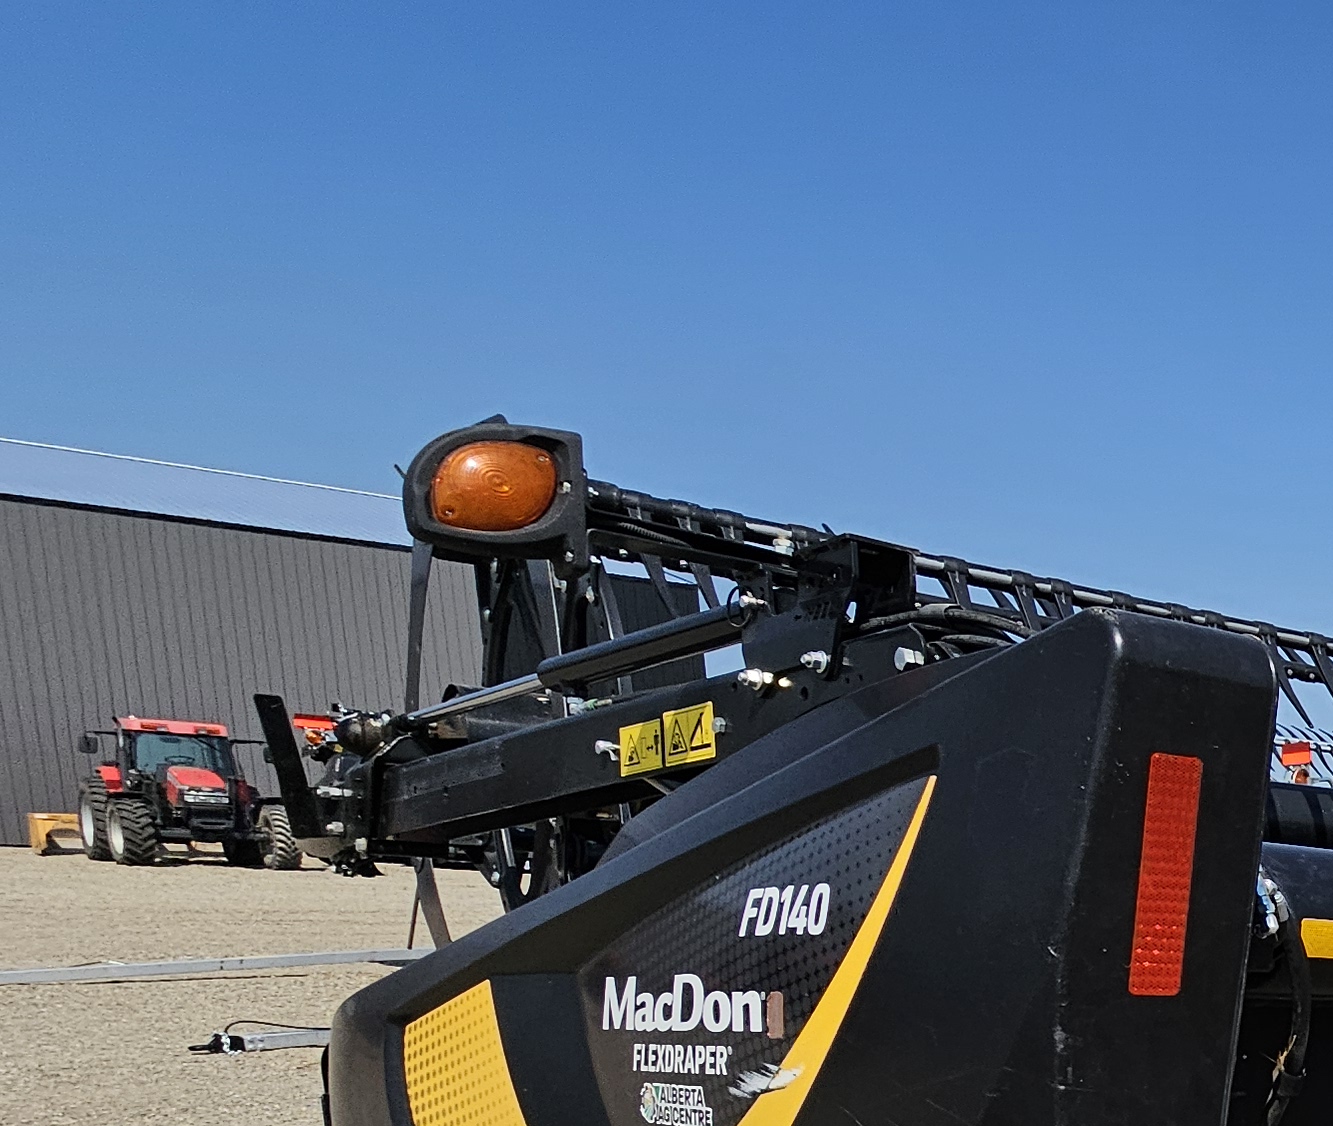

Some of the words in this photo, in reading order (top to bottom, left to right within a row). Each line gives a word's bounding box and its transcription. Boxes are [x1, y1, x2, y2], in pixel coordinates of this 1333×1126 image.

[738, 883, 831, 937] FD140
[602, 973, 763, 1033] MacDon
[632, 1043, 728, 1076] FLEXDRAPER
[660, 1085, 705, 1107] ALBERTA
[672, 1106, 711, 1126] CENTRE
